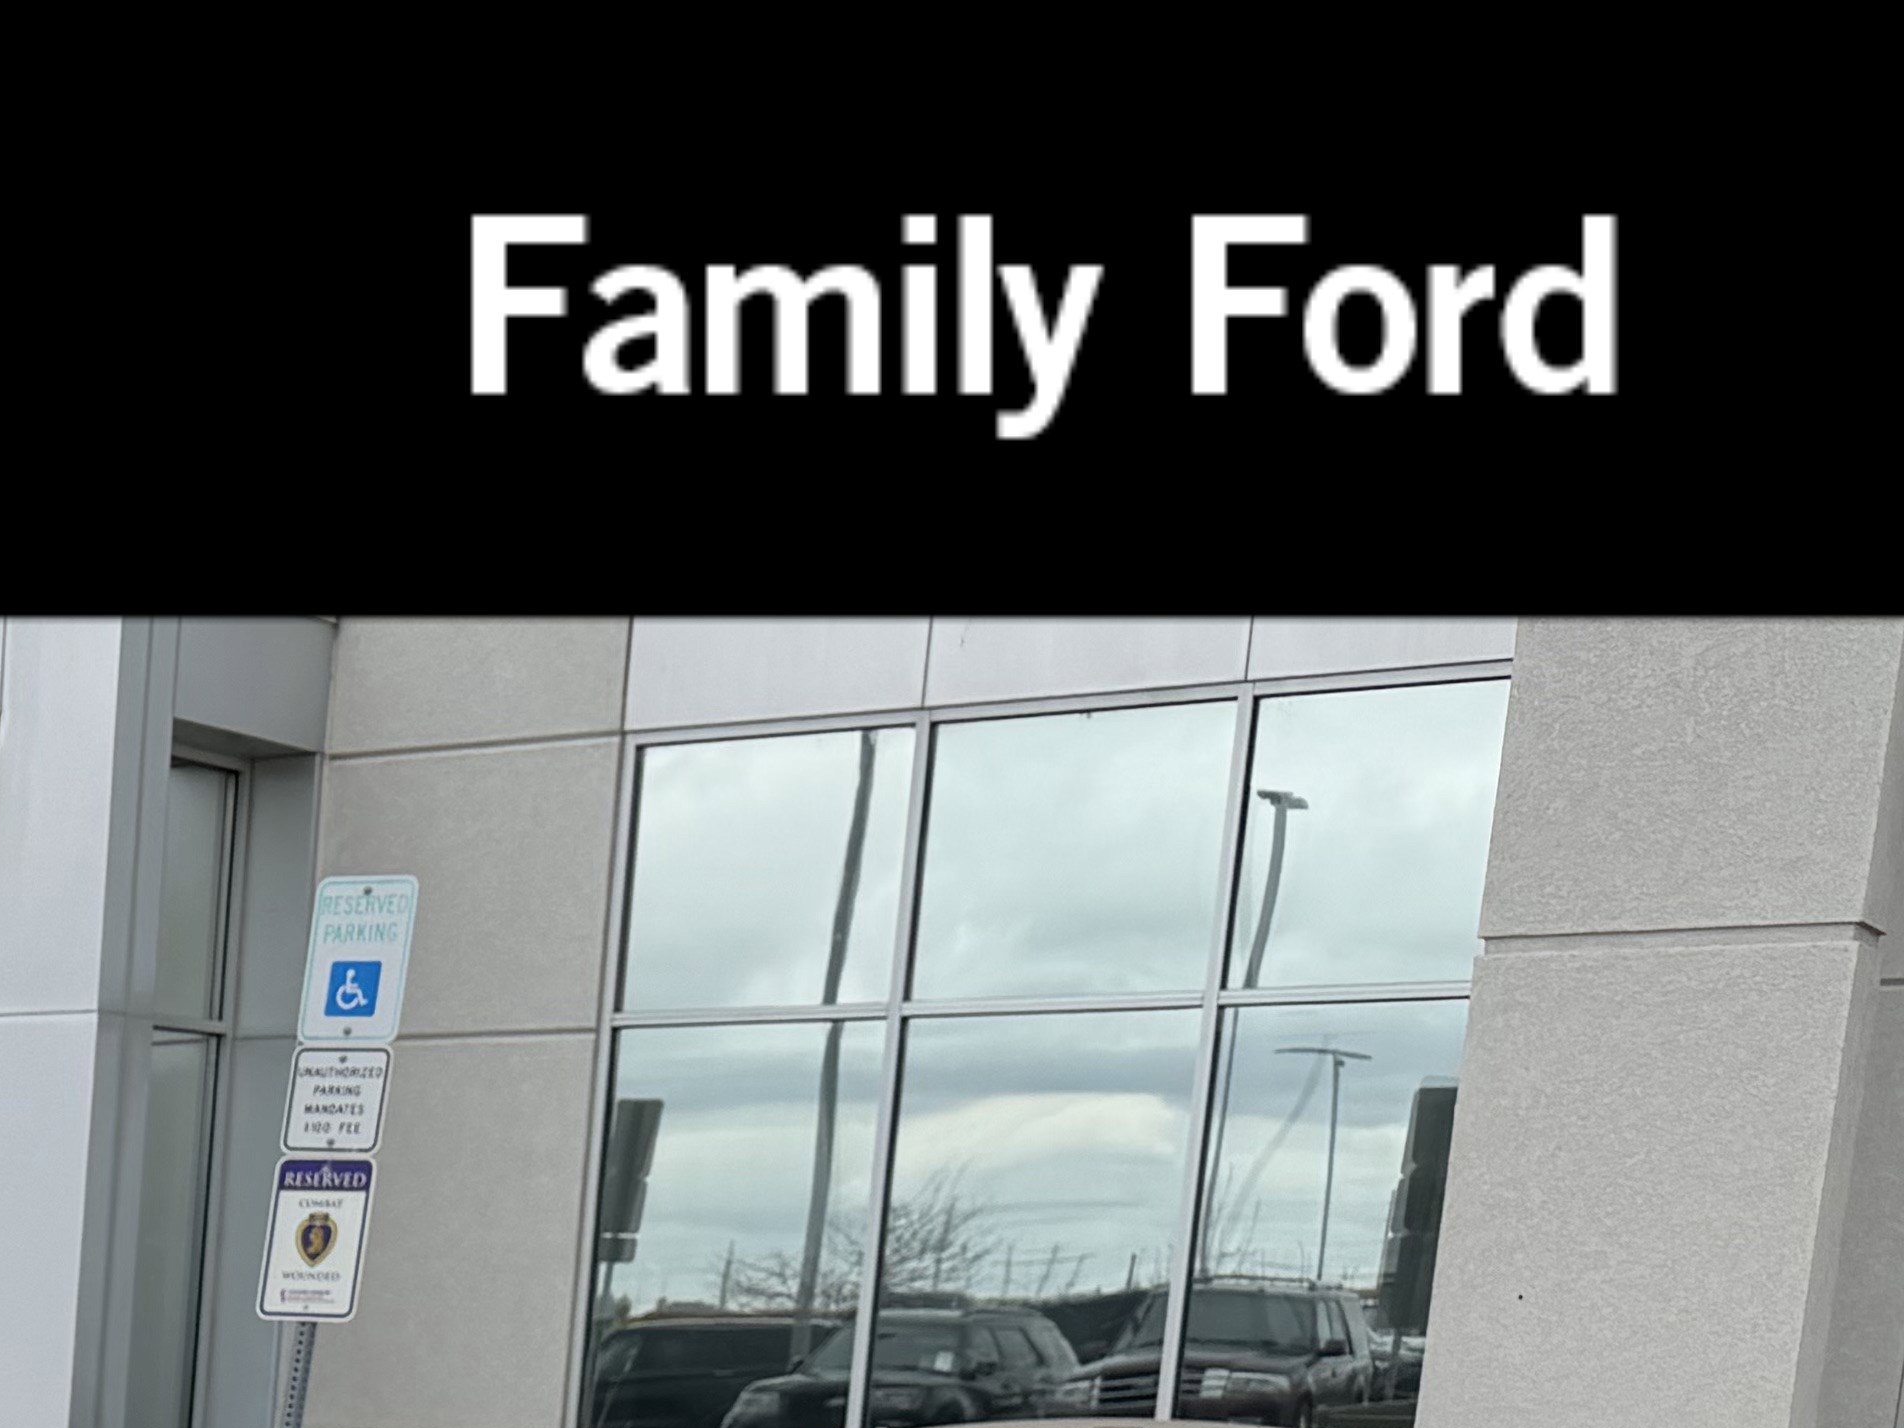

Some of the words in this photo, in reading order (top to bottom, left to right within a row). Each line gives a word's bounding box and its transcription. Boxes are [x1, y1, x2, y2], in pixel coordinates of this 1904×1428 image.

[319, 894, 409, 916] RESERVED
[323, 923, 398, 944] PARKING
[297, 1066, 384, 1078] UNAUTHORIZED
[312, 1084, 362, 1097] PARKING
[303, 1103, 365, 1116] MANDATES
[338, 1121, 362, 1134] FEE
[283, 1170, 368, 1189] RESERVED
[281, 1271, 341, 1280] WOUNDED
